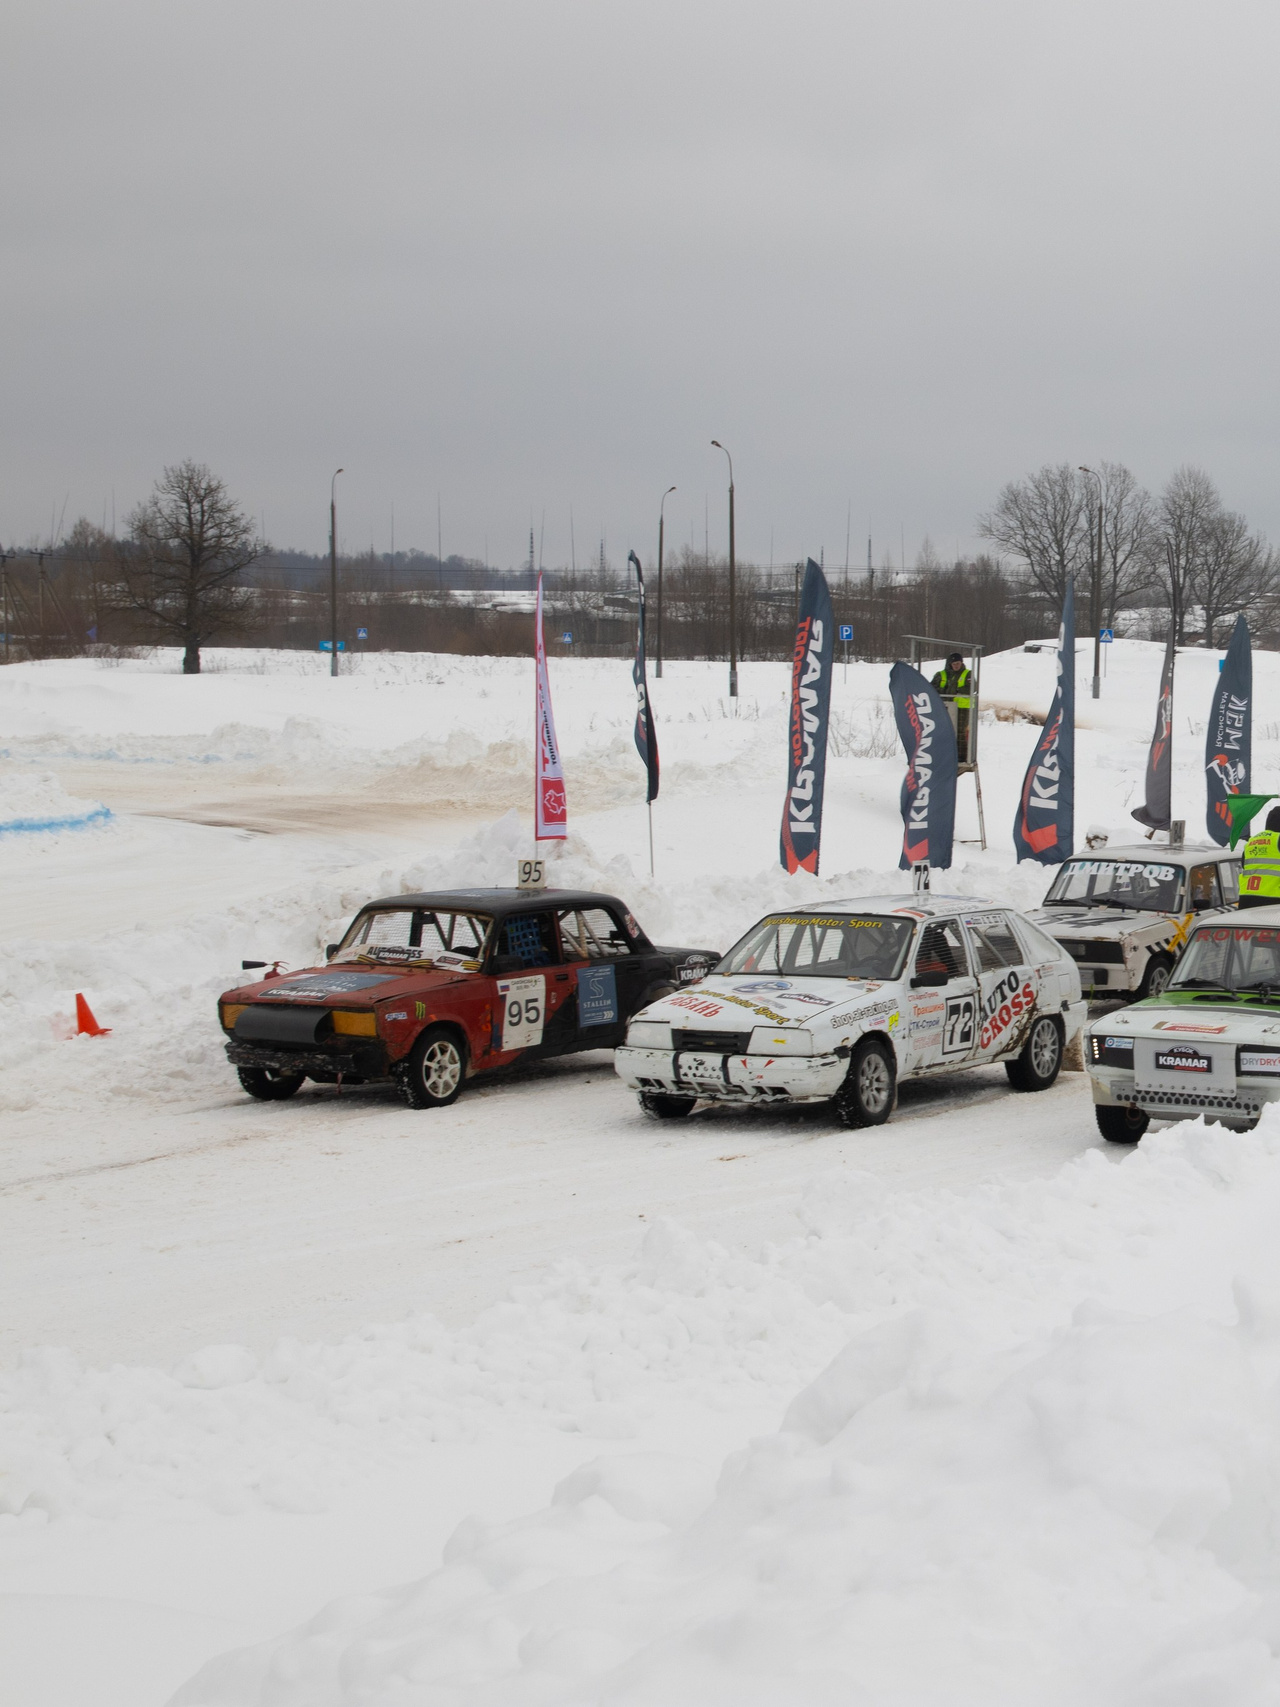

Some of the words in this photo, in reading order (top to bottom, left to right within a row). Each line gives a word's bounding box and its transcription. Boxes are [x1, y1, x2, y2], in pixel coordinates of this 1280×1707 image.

[519, 861, 542, 883] 95
[914, 864, 930, 891] 72
[1064, 862, 1176, 881] ДМИТРОВ
[508, 998, 541, 1026] 95
[912, 1003, 945, 1017] Тракшина
[980, 983, 1034, 1049] CROSS
[948, 1001, 974, 1046] 72
[1158, 1056, 1208, 1068] KRAMAR
[1241, 1057, 1277, 1067] DRYDRY
